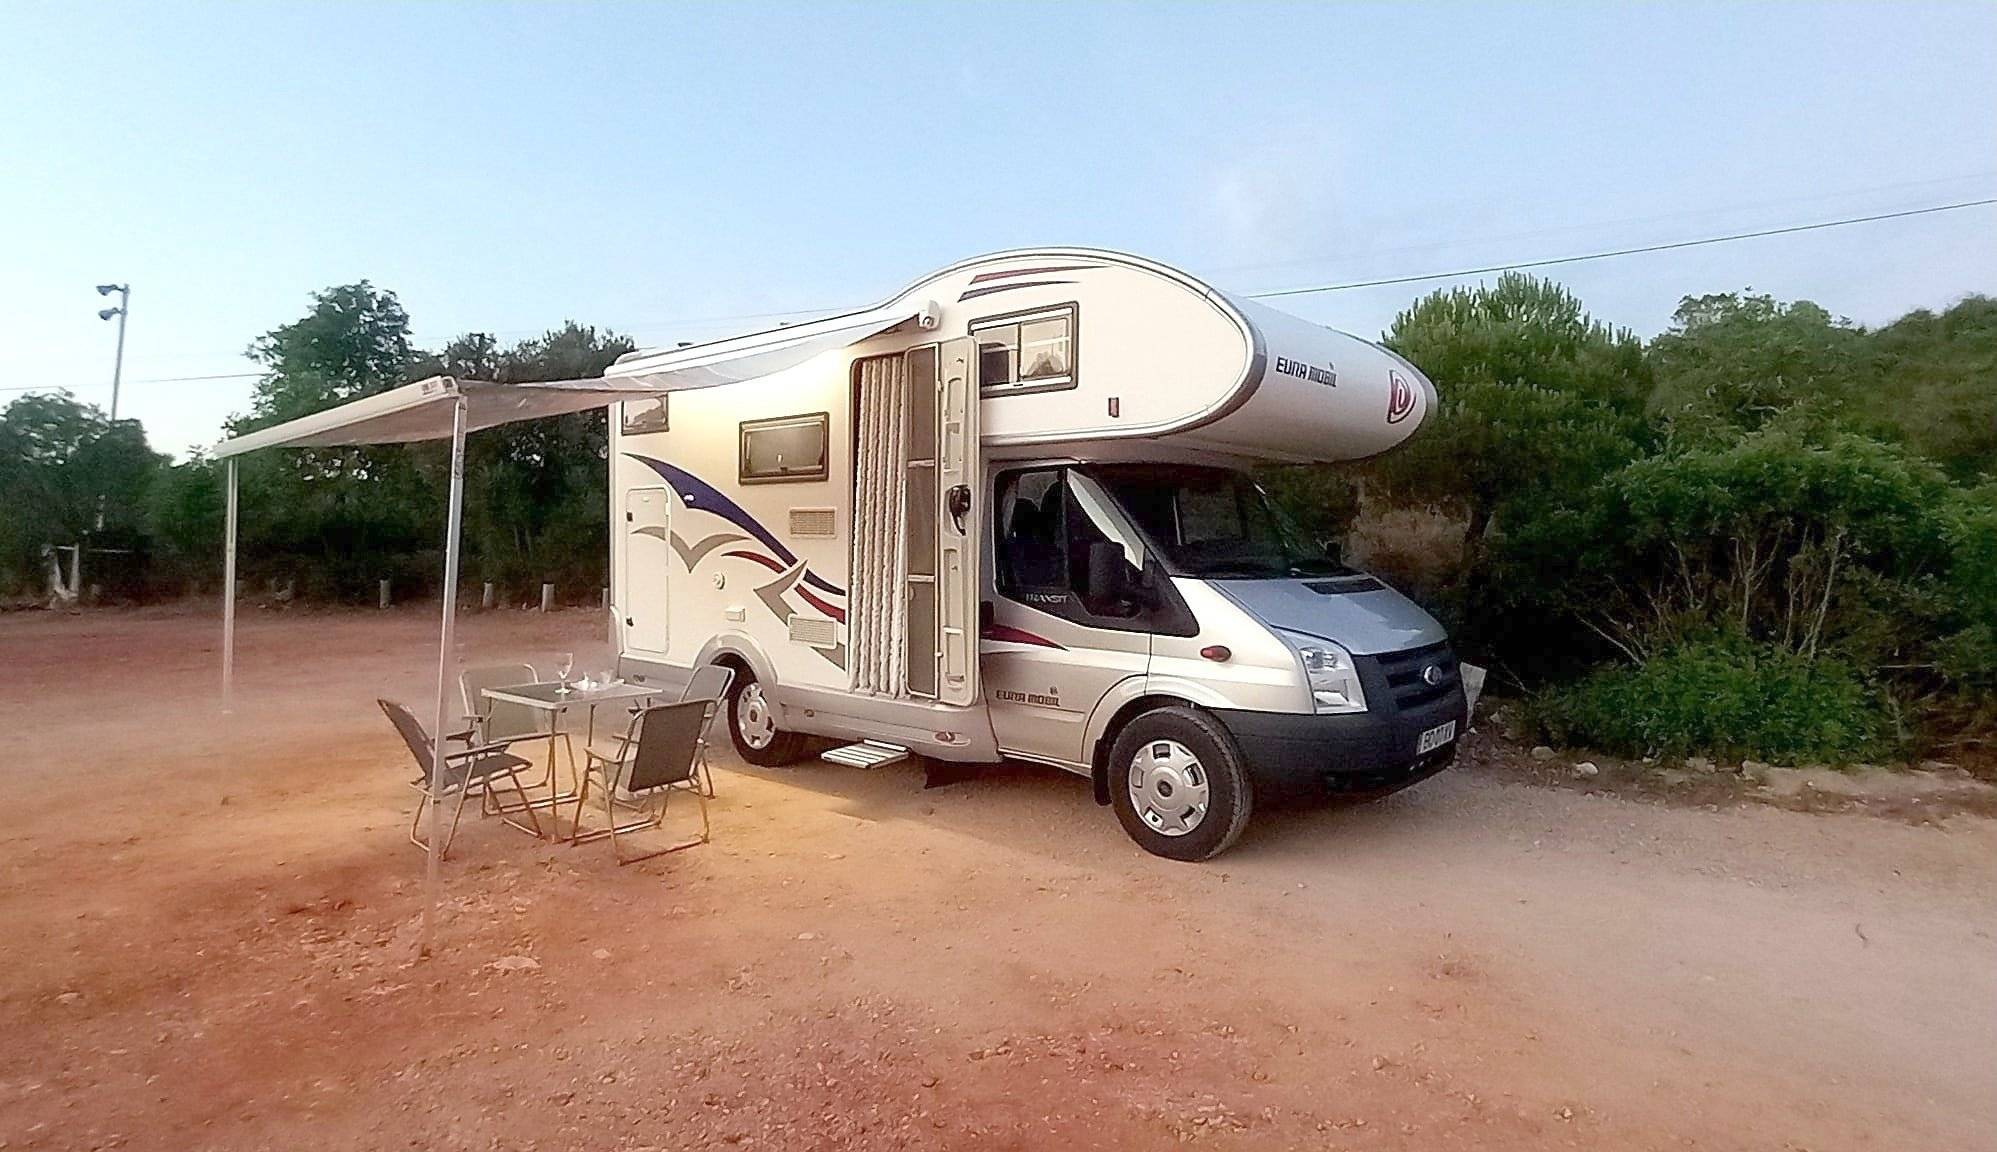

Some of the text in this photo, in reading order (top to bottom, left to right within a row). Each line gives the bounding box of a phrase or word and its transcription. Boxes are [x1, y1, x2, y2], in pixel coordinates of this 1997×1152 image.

[1275, 356, 1338, 388] EURA MOBIL
[1027, 693, 1061, 707] MOBIL
